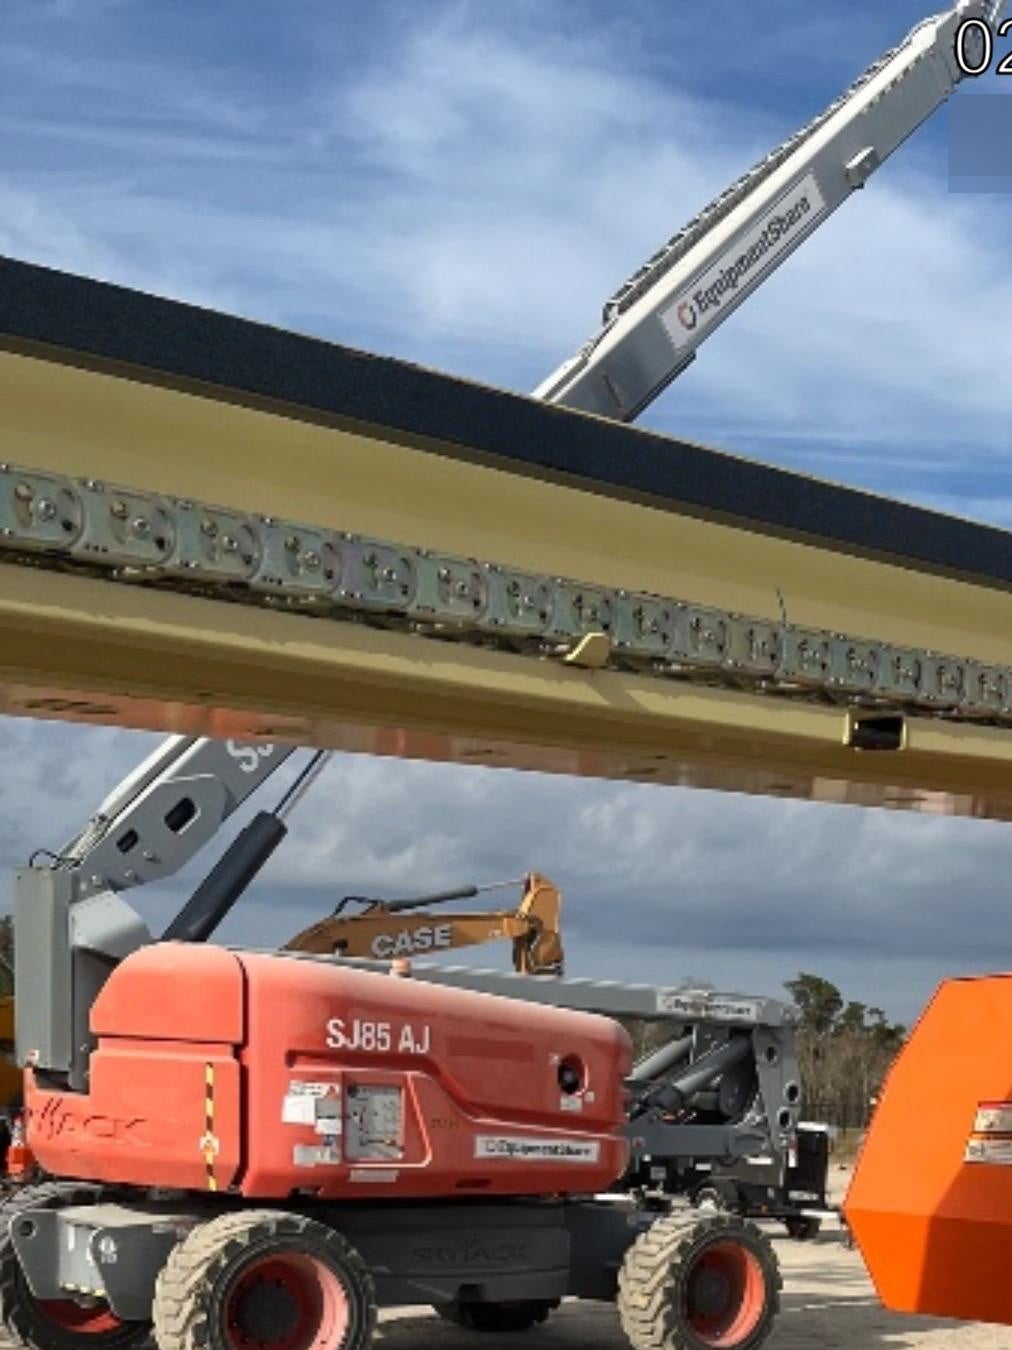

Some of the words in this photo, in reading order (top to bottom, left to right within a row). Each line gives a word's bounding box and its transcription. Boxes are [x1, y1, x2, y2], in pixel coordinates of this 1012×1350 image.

[371, 923, 453, 958] CASE
[325, 1018, 392, 1051] SJ85
[398, 1024, 431, 1054] AJ
